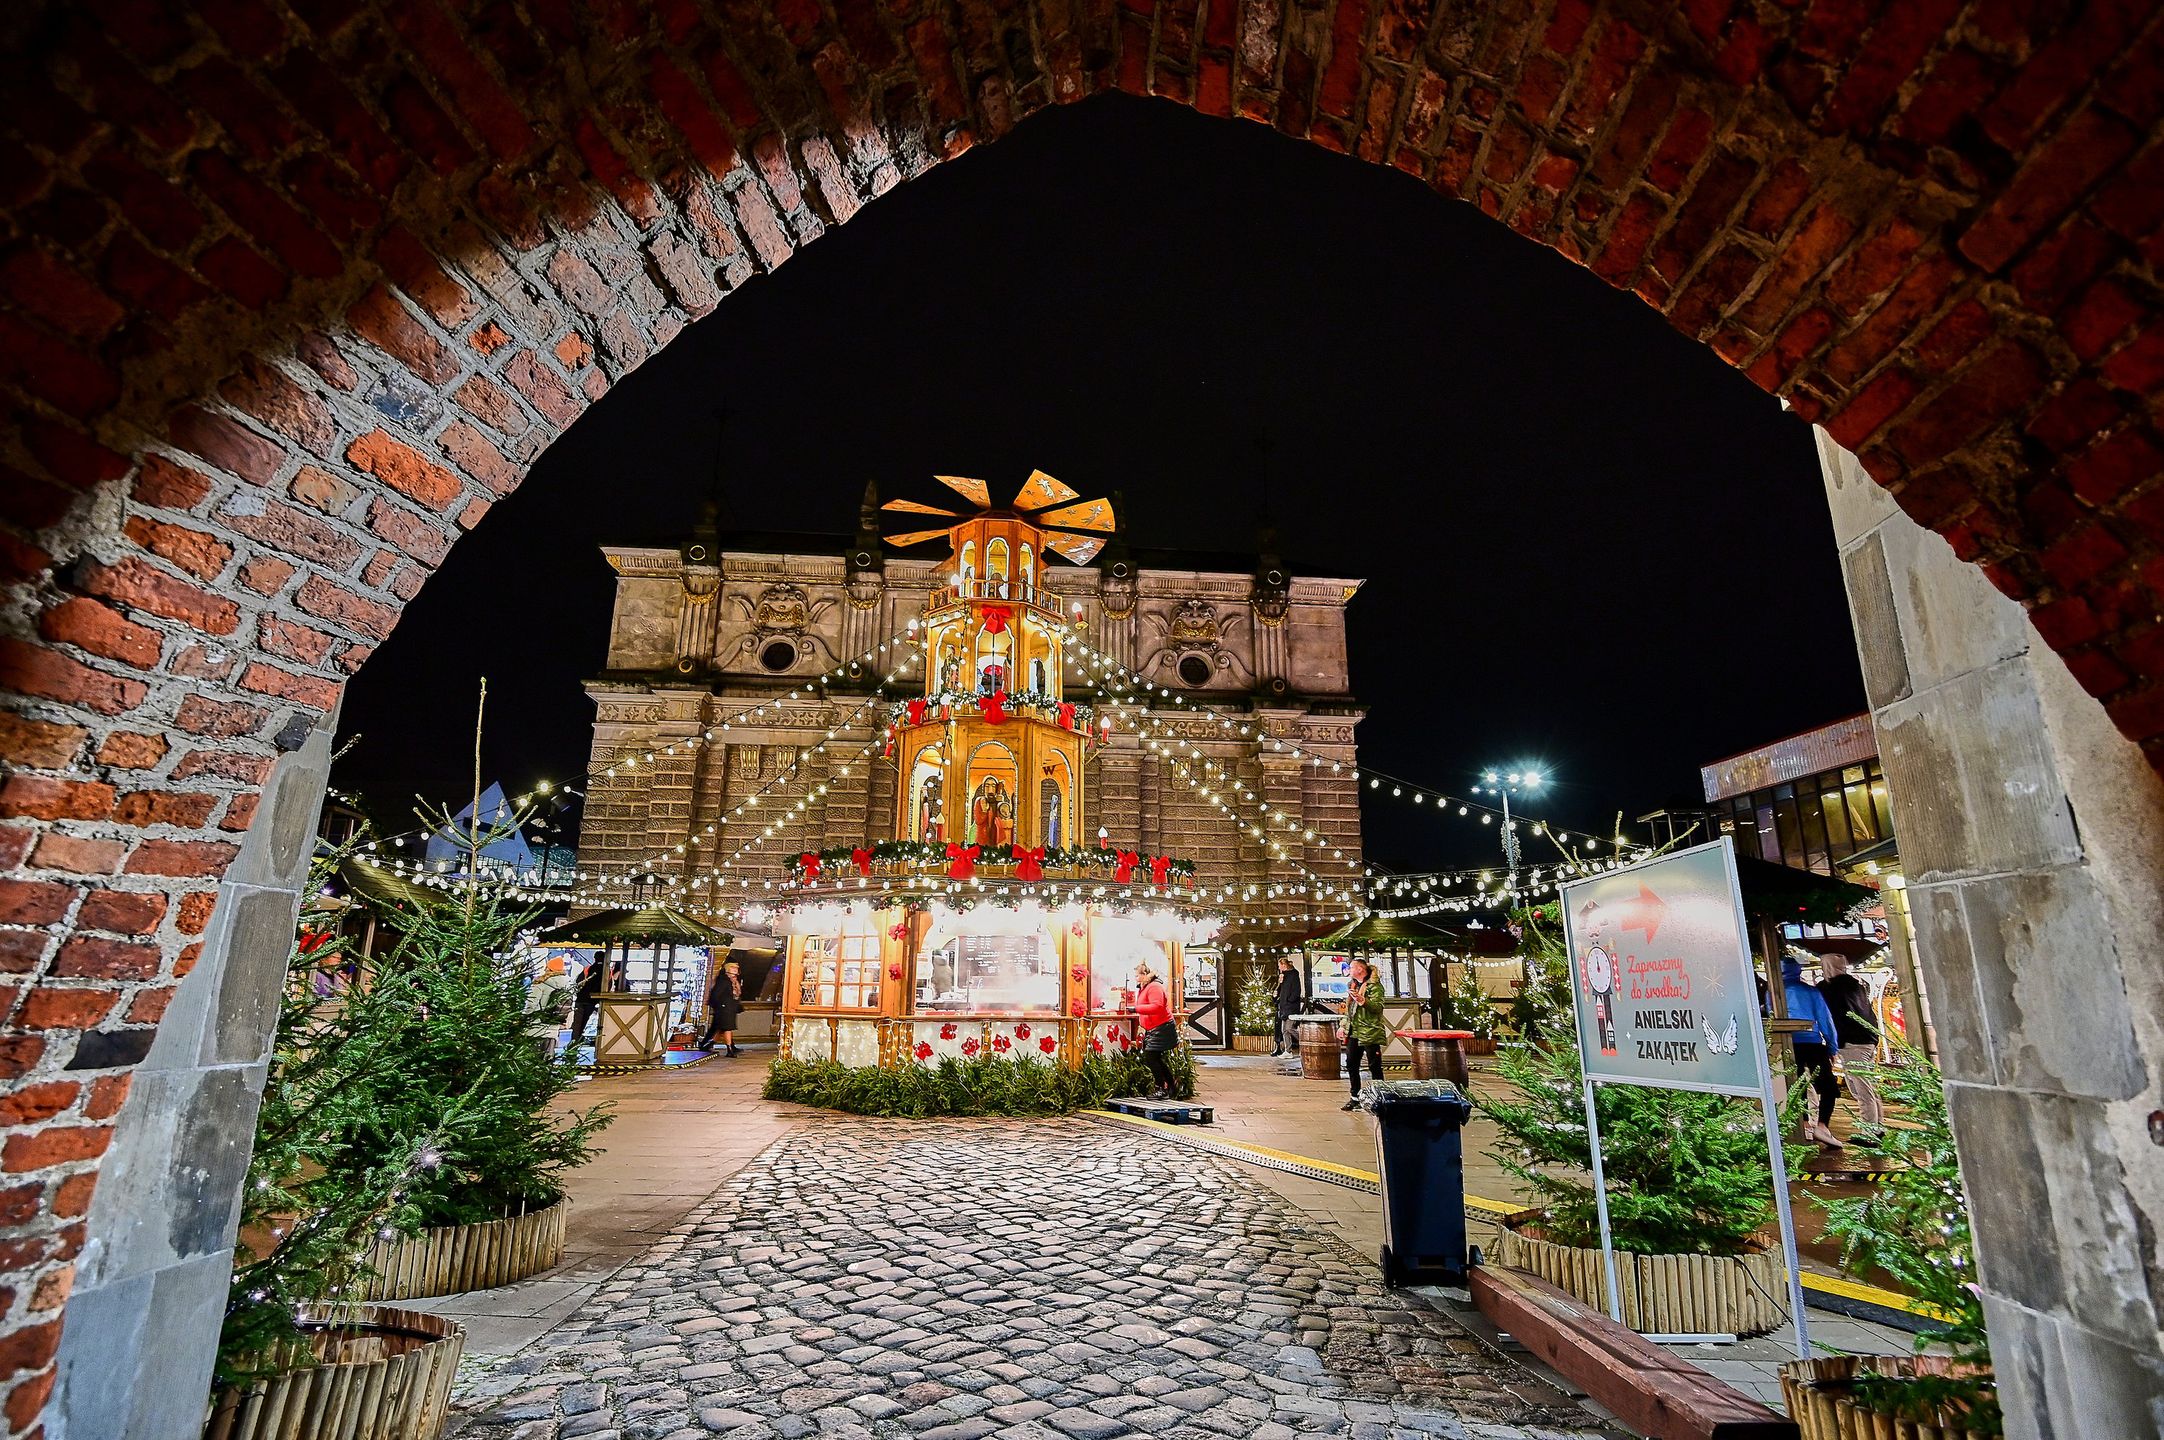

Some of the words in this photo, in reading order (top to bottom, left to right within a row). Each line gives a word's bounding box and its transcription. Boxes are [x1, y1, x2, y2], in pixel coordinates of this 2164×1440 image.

[1275, 719, 1286, 736] 4
[1042, 764, 1057, 776] W
[1631, 978, 1642, 1000] do
[1634, 1009, 1694, 1030] ANIELSKI
[1636, 1040, 1699, 1066] ZAKĄTEK
